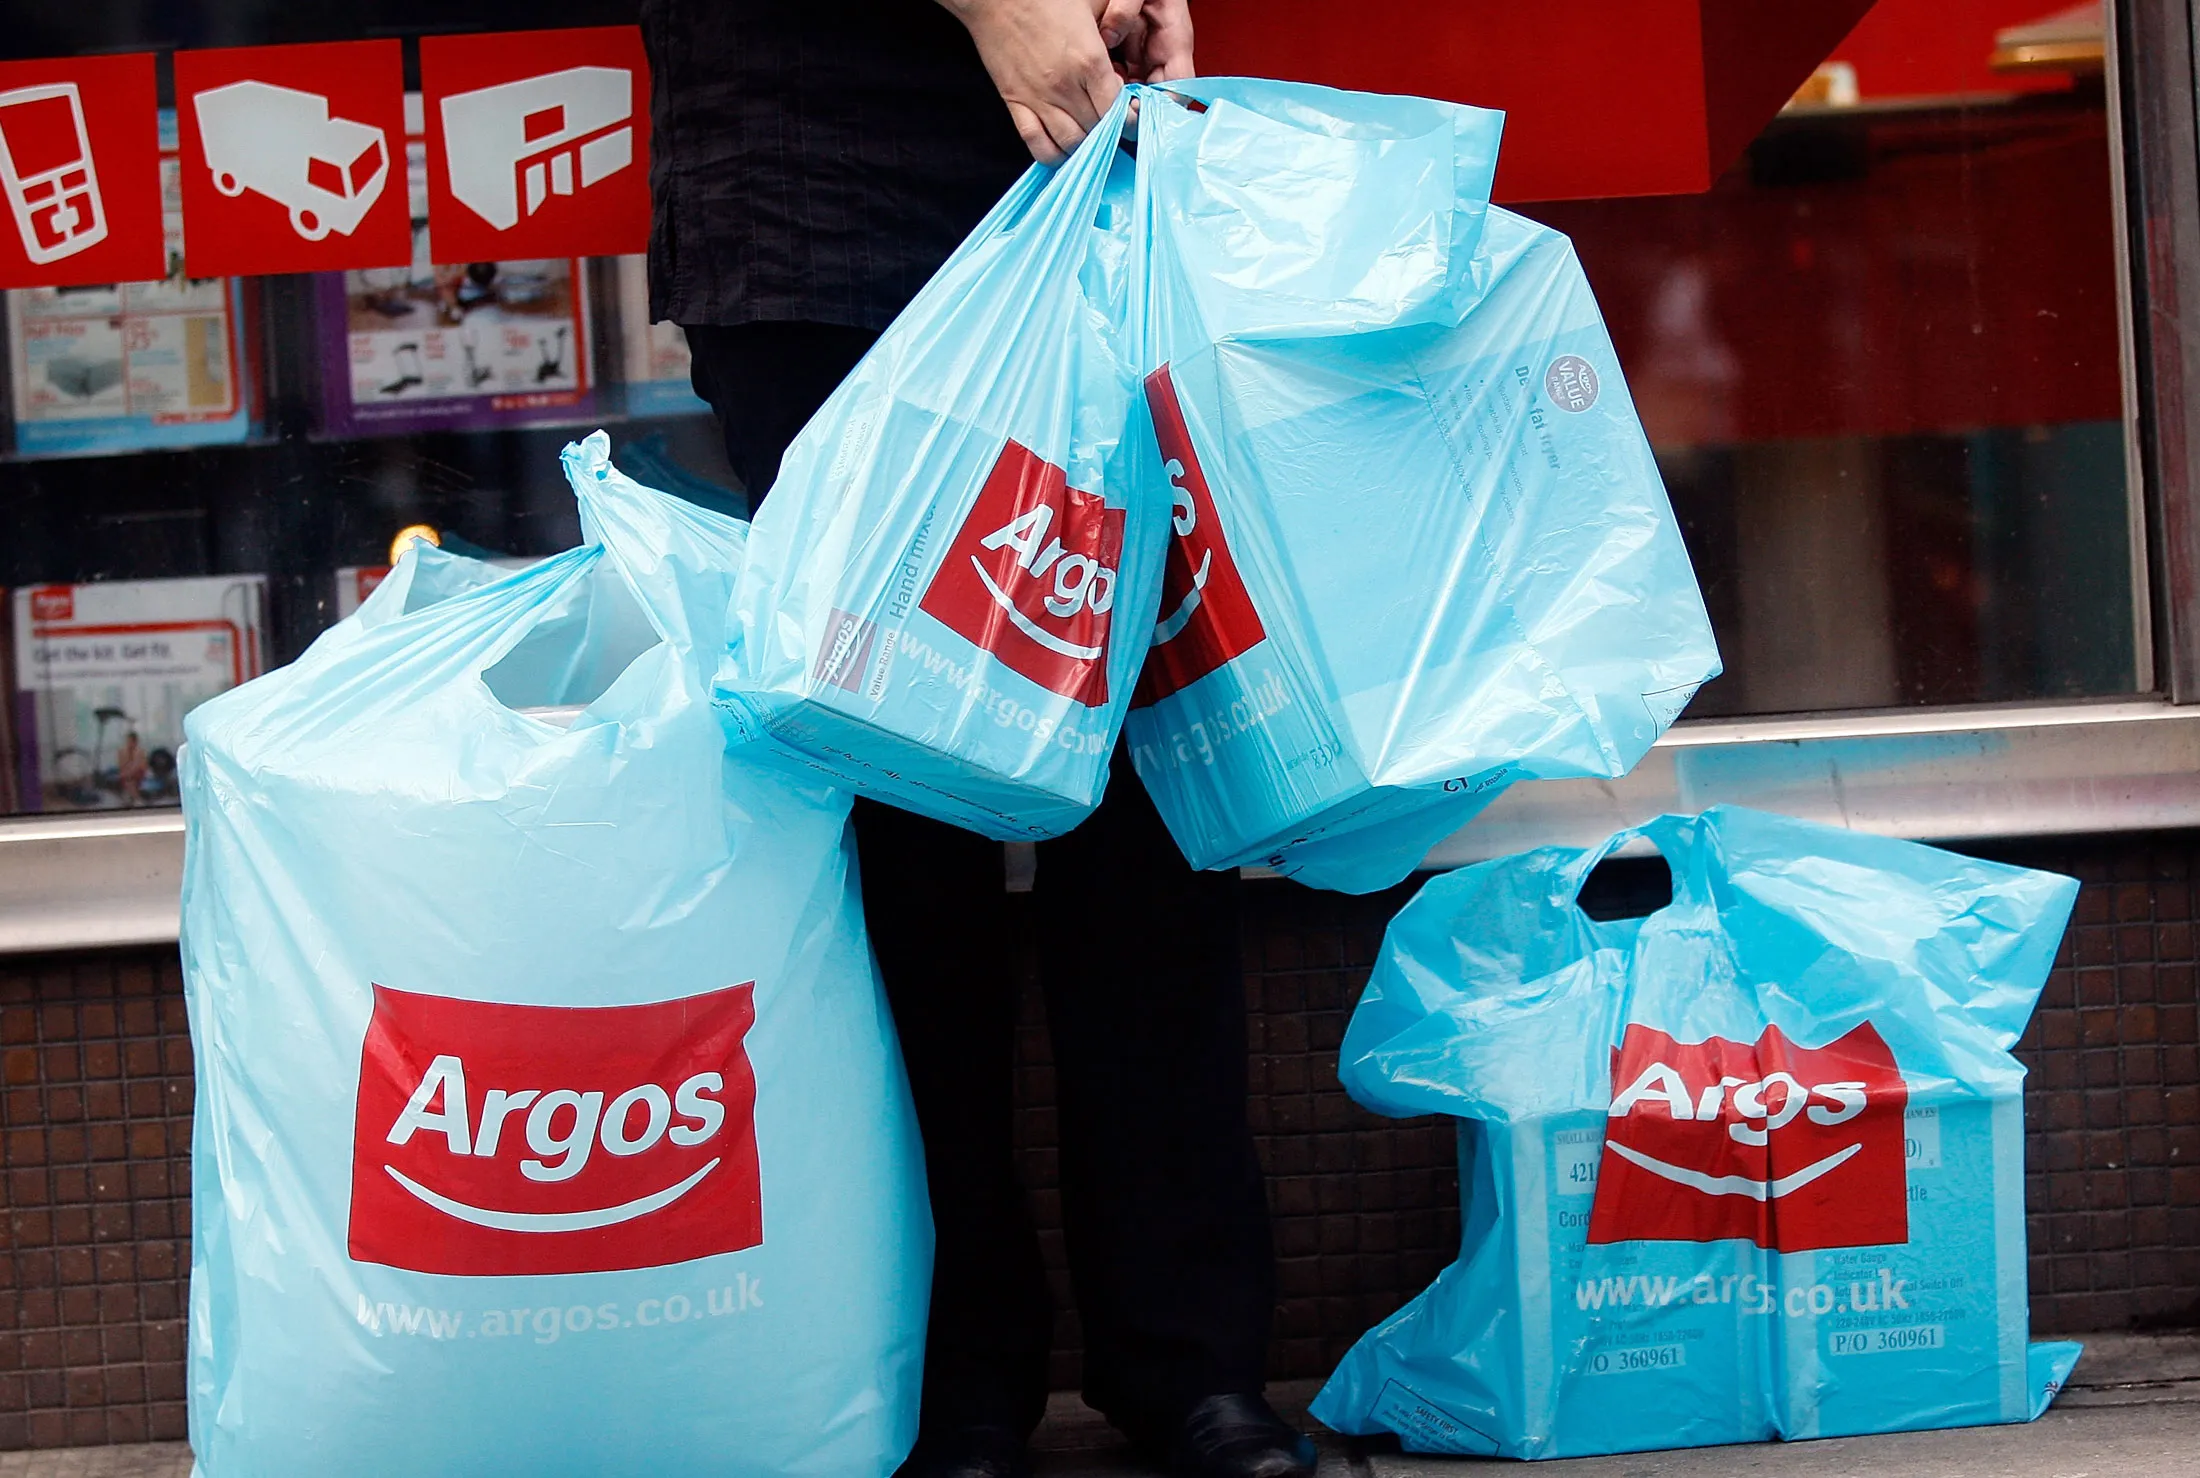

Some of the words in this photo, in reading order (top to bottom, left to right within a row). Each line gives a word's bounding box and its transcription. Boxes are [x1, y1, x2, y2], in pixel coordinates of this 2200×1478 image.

[1559, 360, 1585, 409] VALUE
[1530, 407, 1544, 430] fat
[889, 563, 919, 620] Hand
[911, 505, 936, 559] mixe
[869, 665, 885, 697] Value
[878, 631, 896, 666] Range
[386, 1054, 726, 1182] Argos
[1905, 1108, 1936, 1119] IANCES
[1569, 1162, 1597, 1183] 421
[356, 1271, 765, 1346] www.argos.co.uk
[1835, 1333, 1869, 1353] P/O
[1877, 1327, 1937, 1350] 360961
[1586, 1354, 1609, 1374] /O
[1618, 1347, 1679, 1371] 360961
